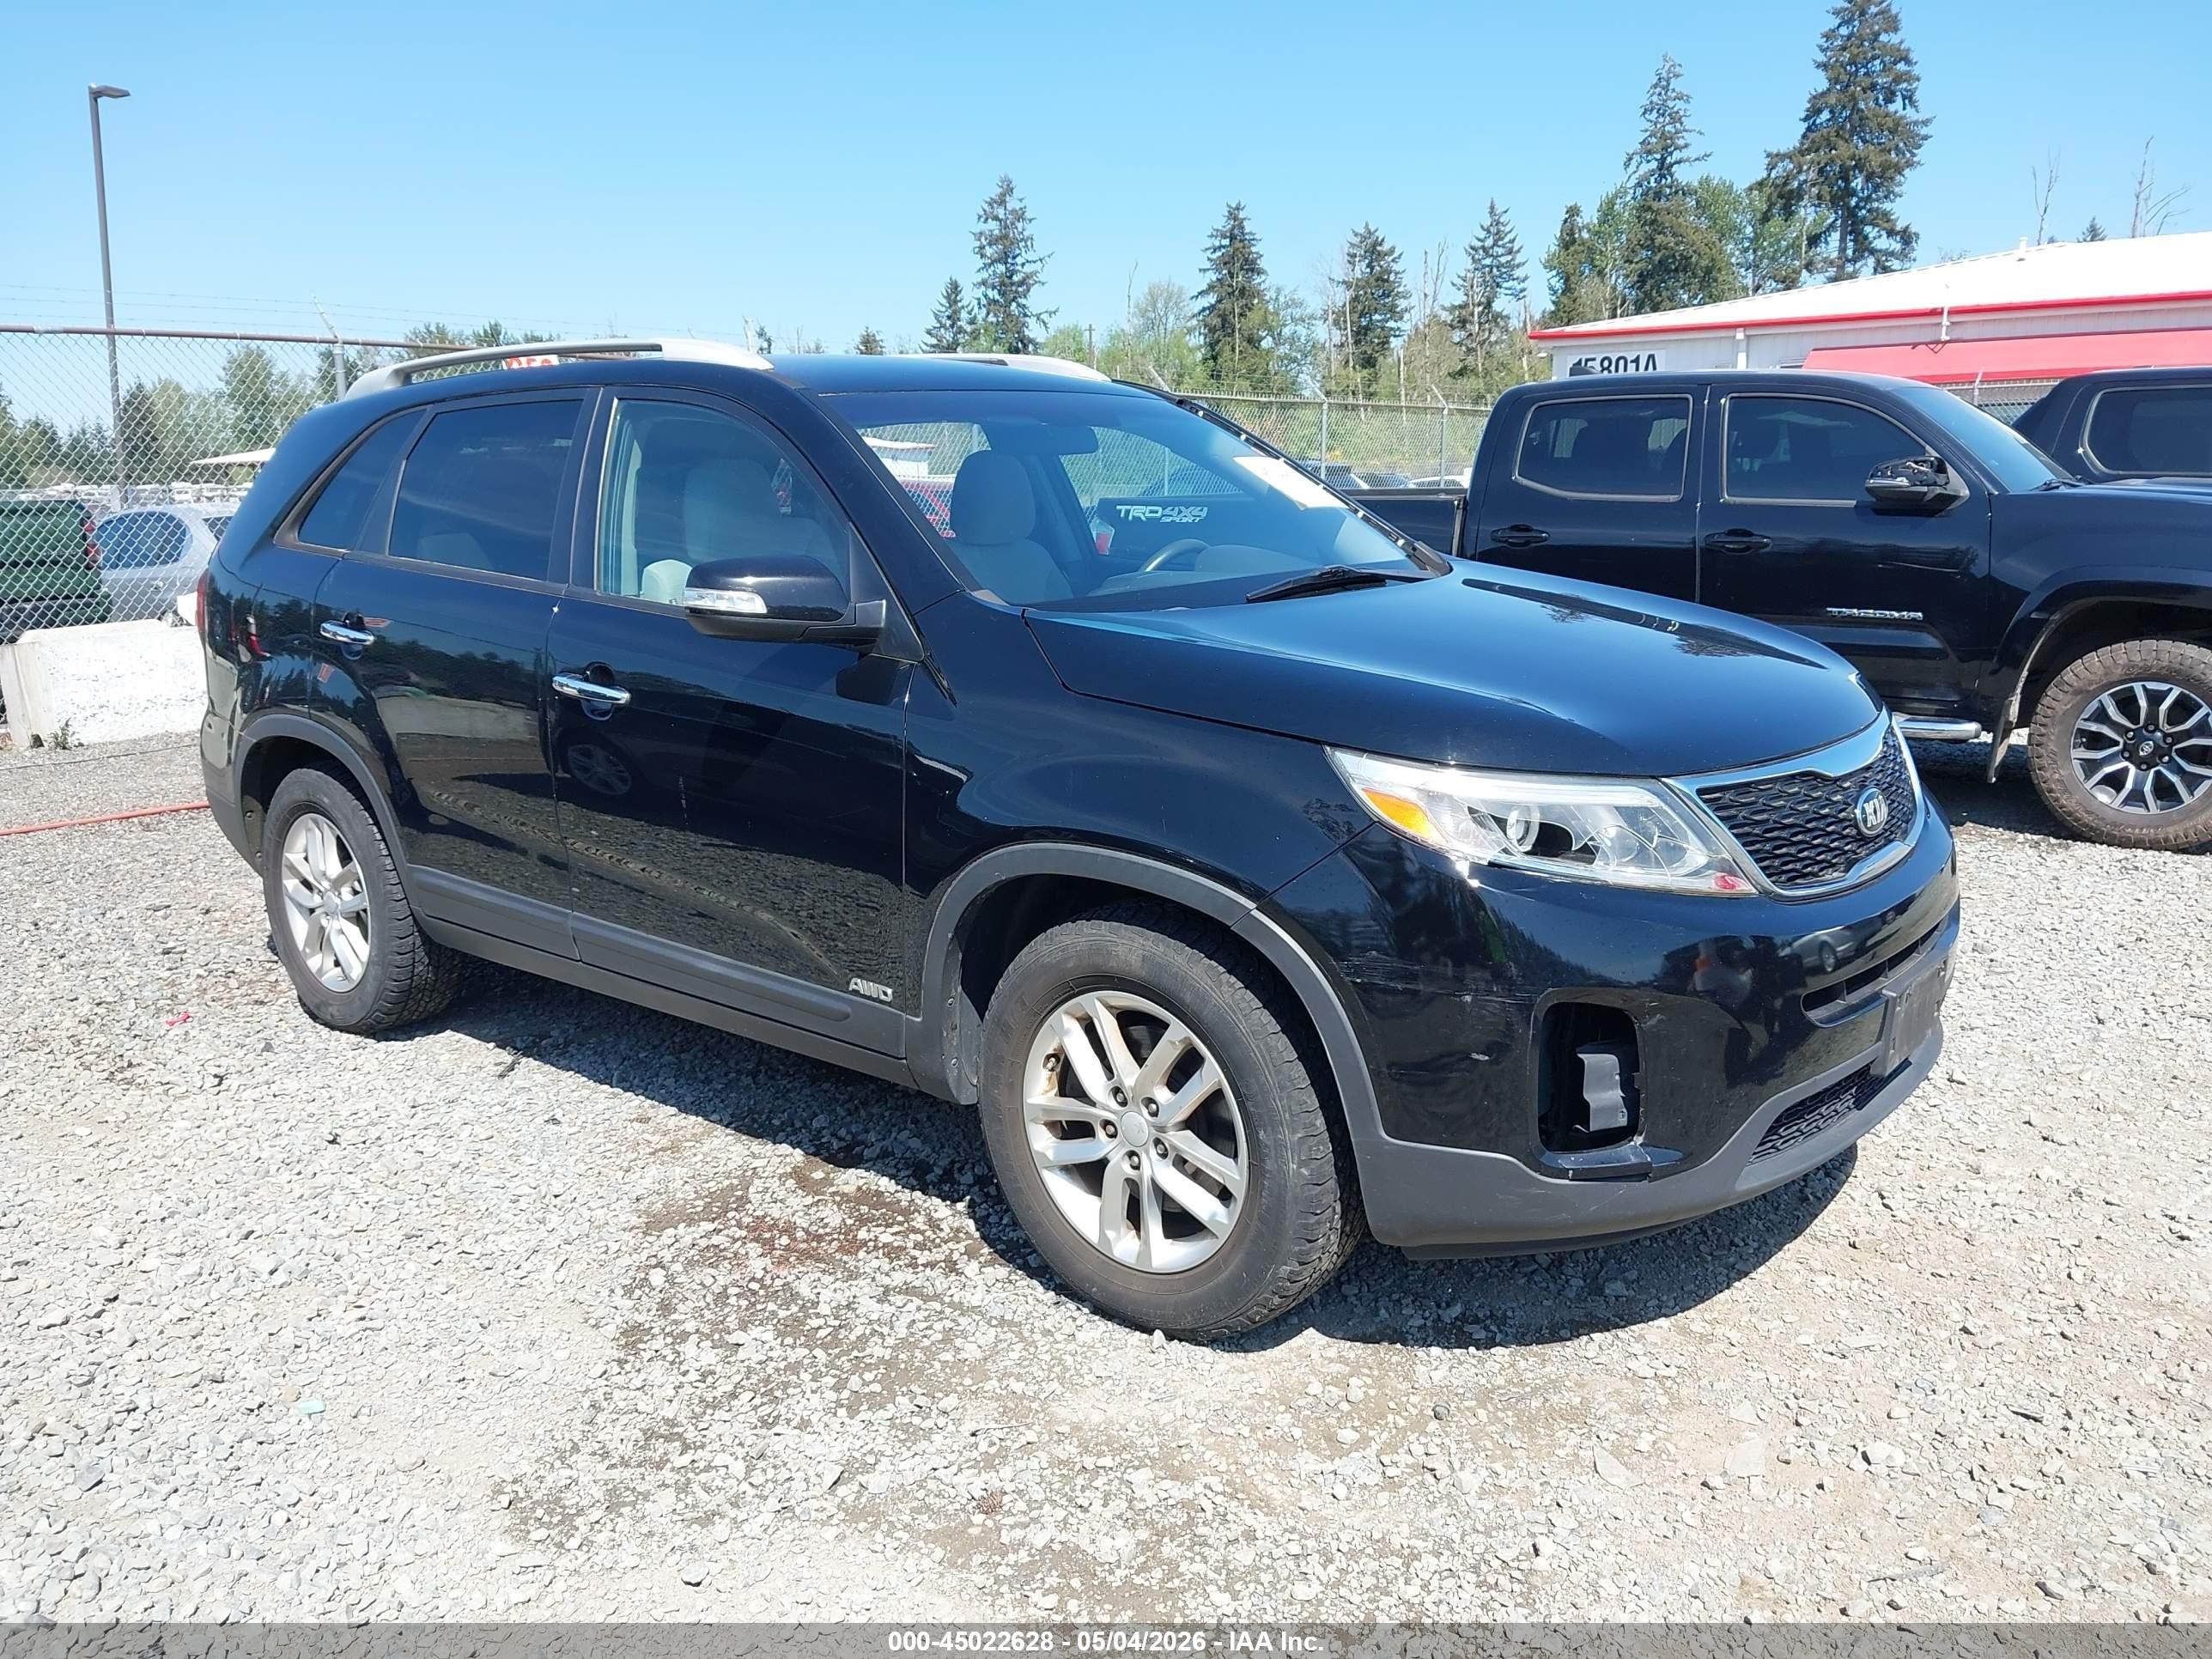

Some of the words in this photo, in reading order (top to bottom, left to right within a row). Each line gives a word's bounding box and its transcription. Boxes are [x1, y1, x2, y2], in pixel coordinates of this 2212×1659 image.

[1826, 607, 1923, 620] TACOMA
[1863, 794, 1887, 827] KIA
[848, 977, 893, 1002] AWD
